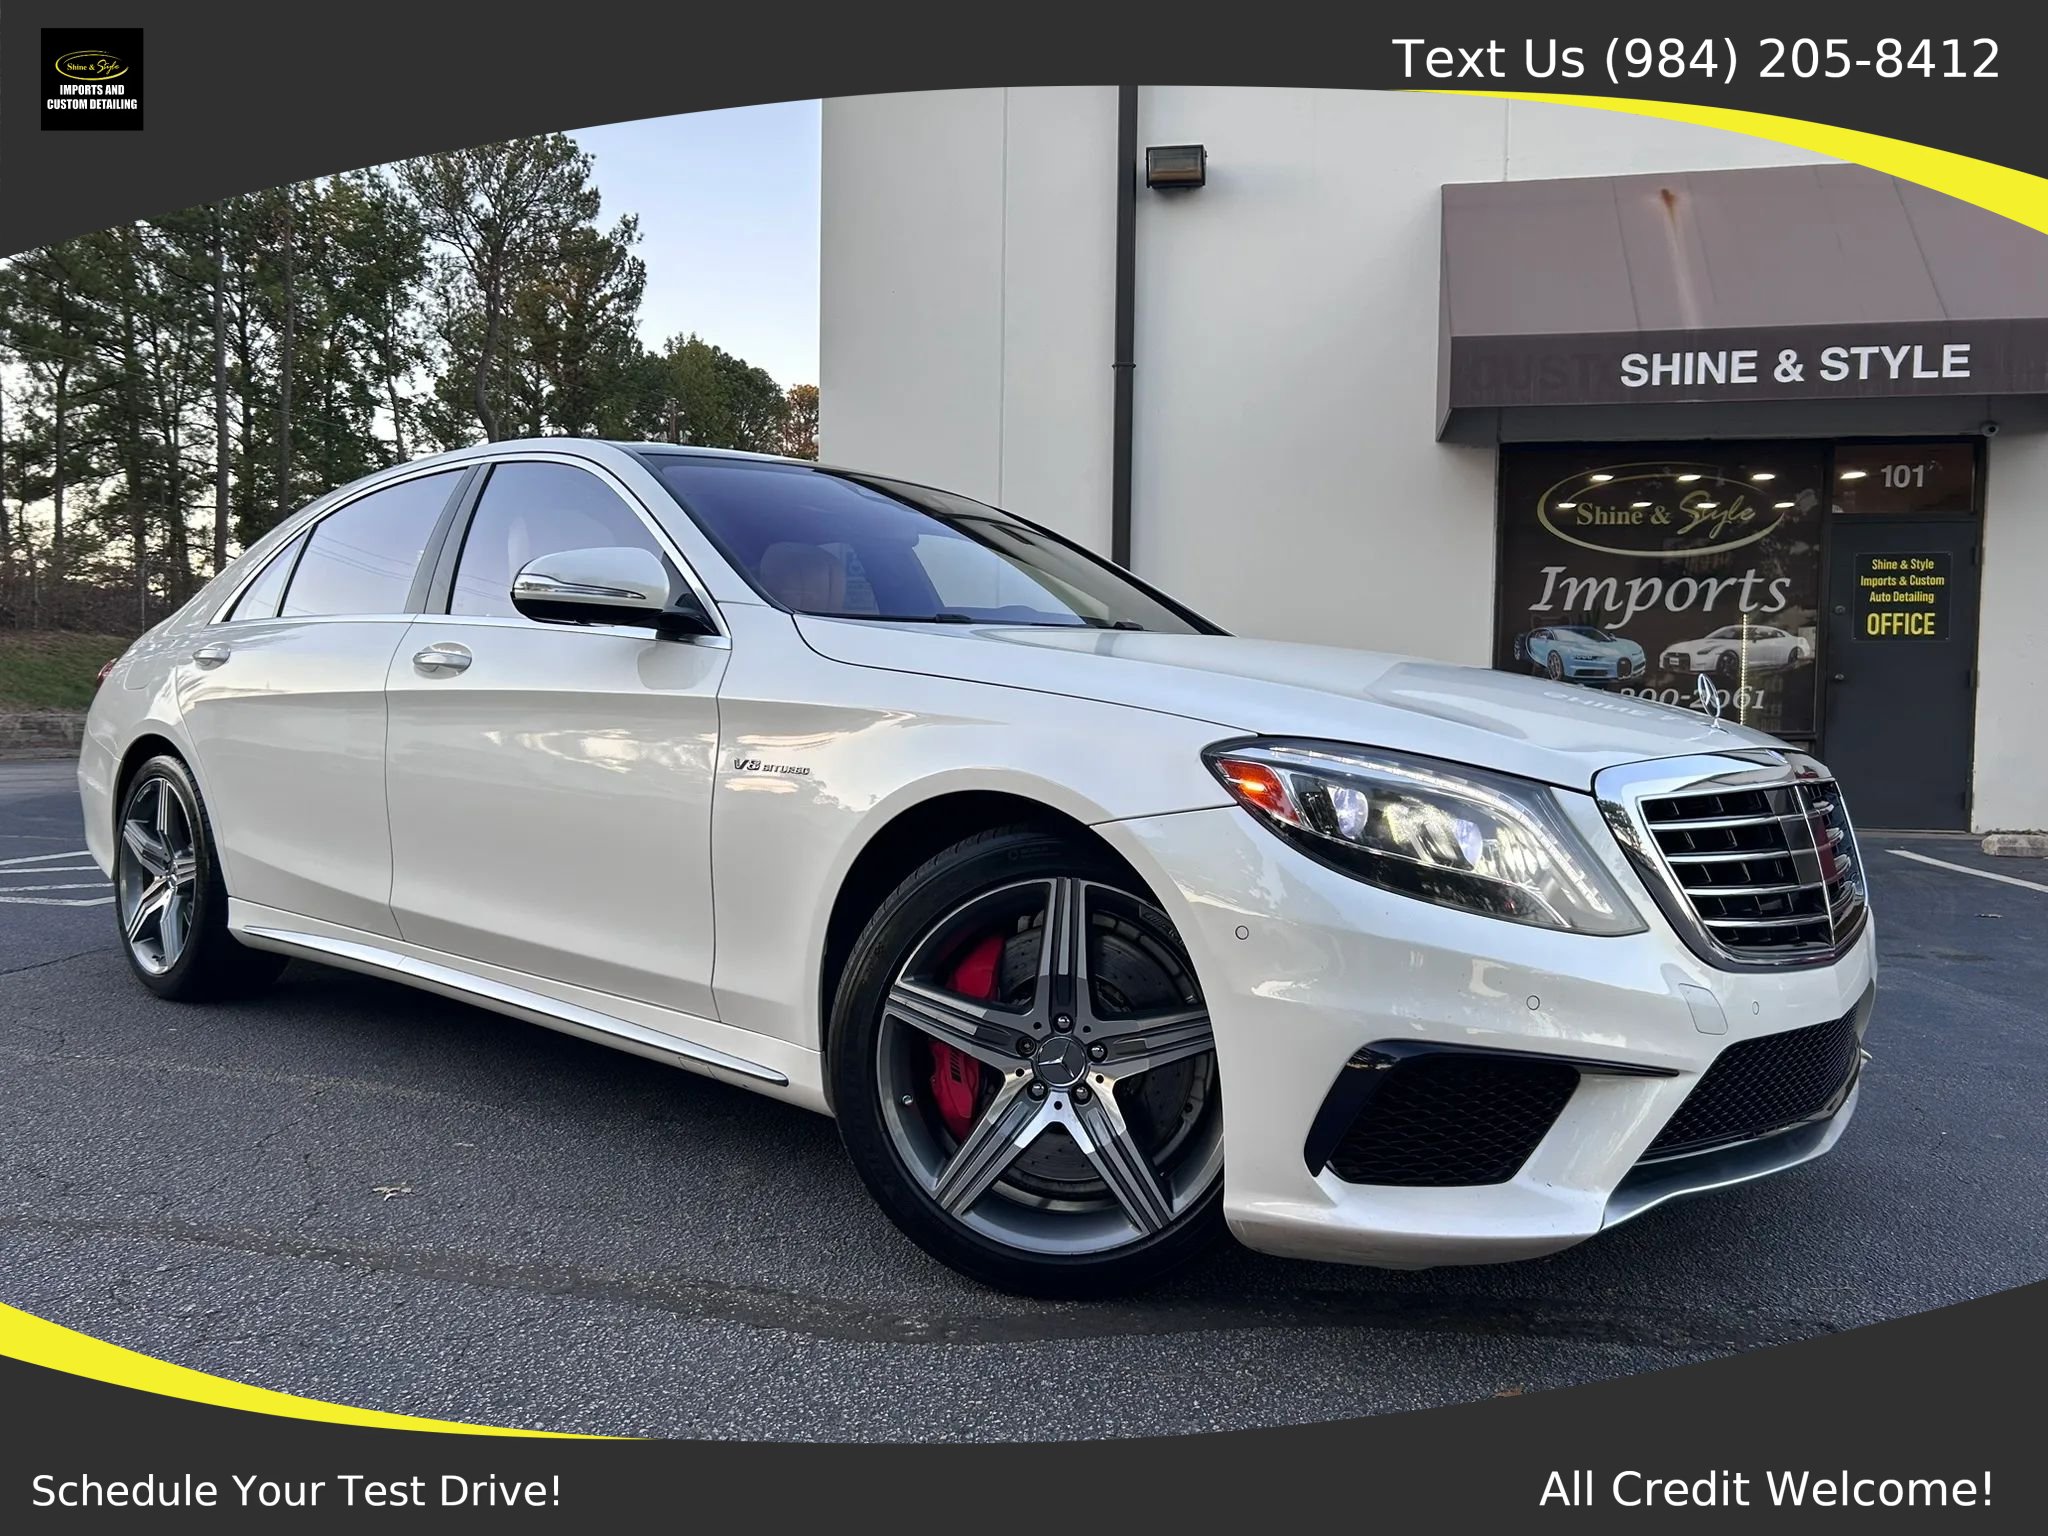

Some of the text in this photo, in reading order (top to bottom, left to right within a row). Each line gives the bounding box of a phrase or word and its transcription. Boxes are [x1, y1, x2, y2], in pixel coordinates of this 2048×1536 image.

[1620, 350, 1758, 388] SHINE
[1773, 349, 1805, 383] &
[1819, 343, 1971, 382] STYLE
[1881, 464, 1925, 488] 101
[1576, 490, 1757, 540] Shine & Style
[1871, 558, 1935, 571] Shine & Style
[1860, 574, 1945, 588] Imports & Custom
[1528, 566, 1792, 630] Imports
[1869, 590, 1935, 604] Auto Detailing
[1867, 612, 1936, 635] OFFICE
[733, 758, 811, 775] V8 BITURBO
